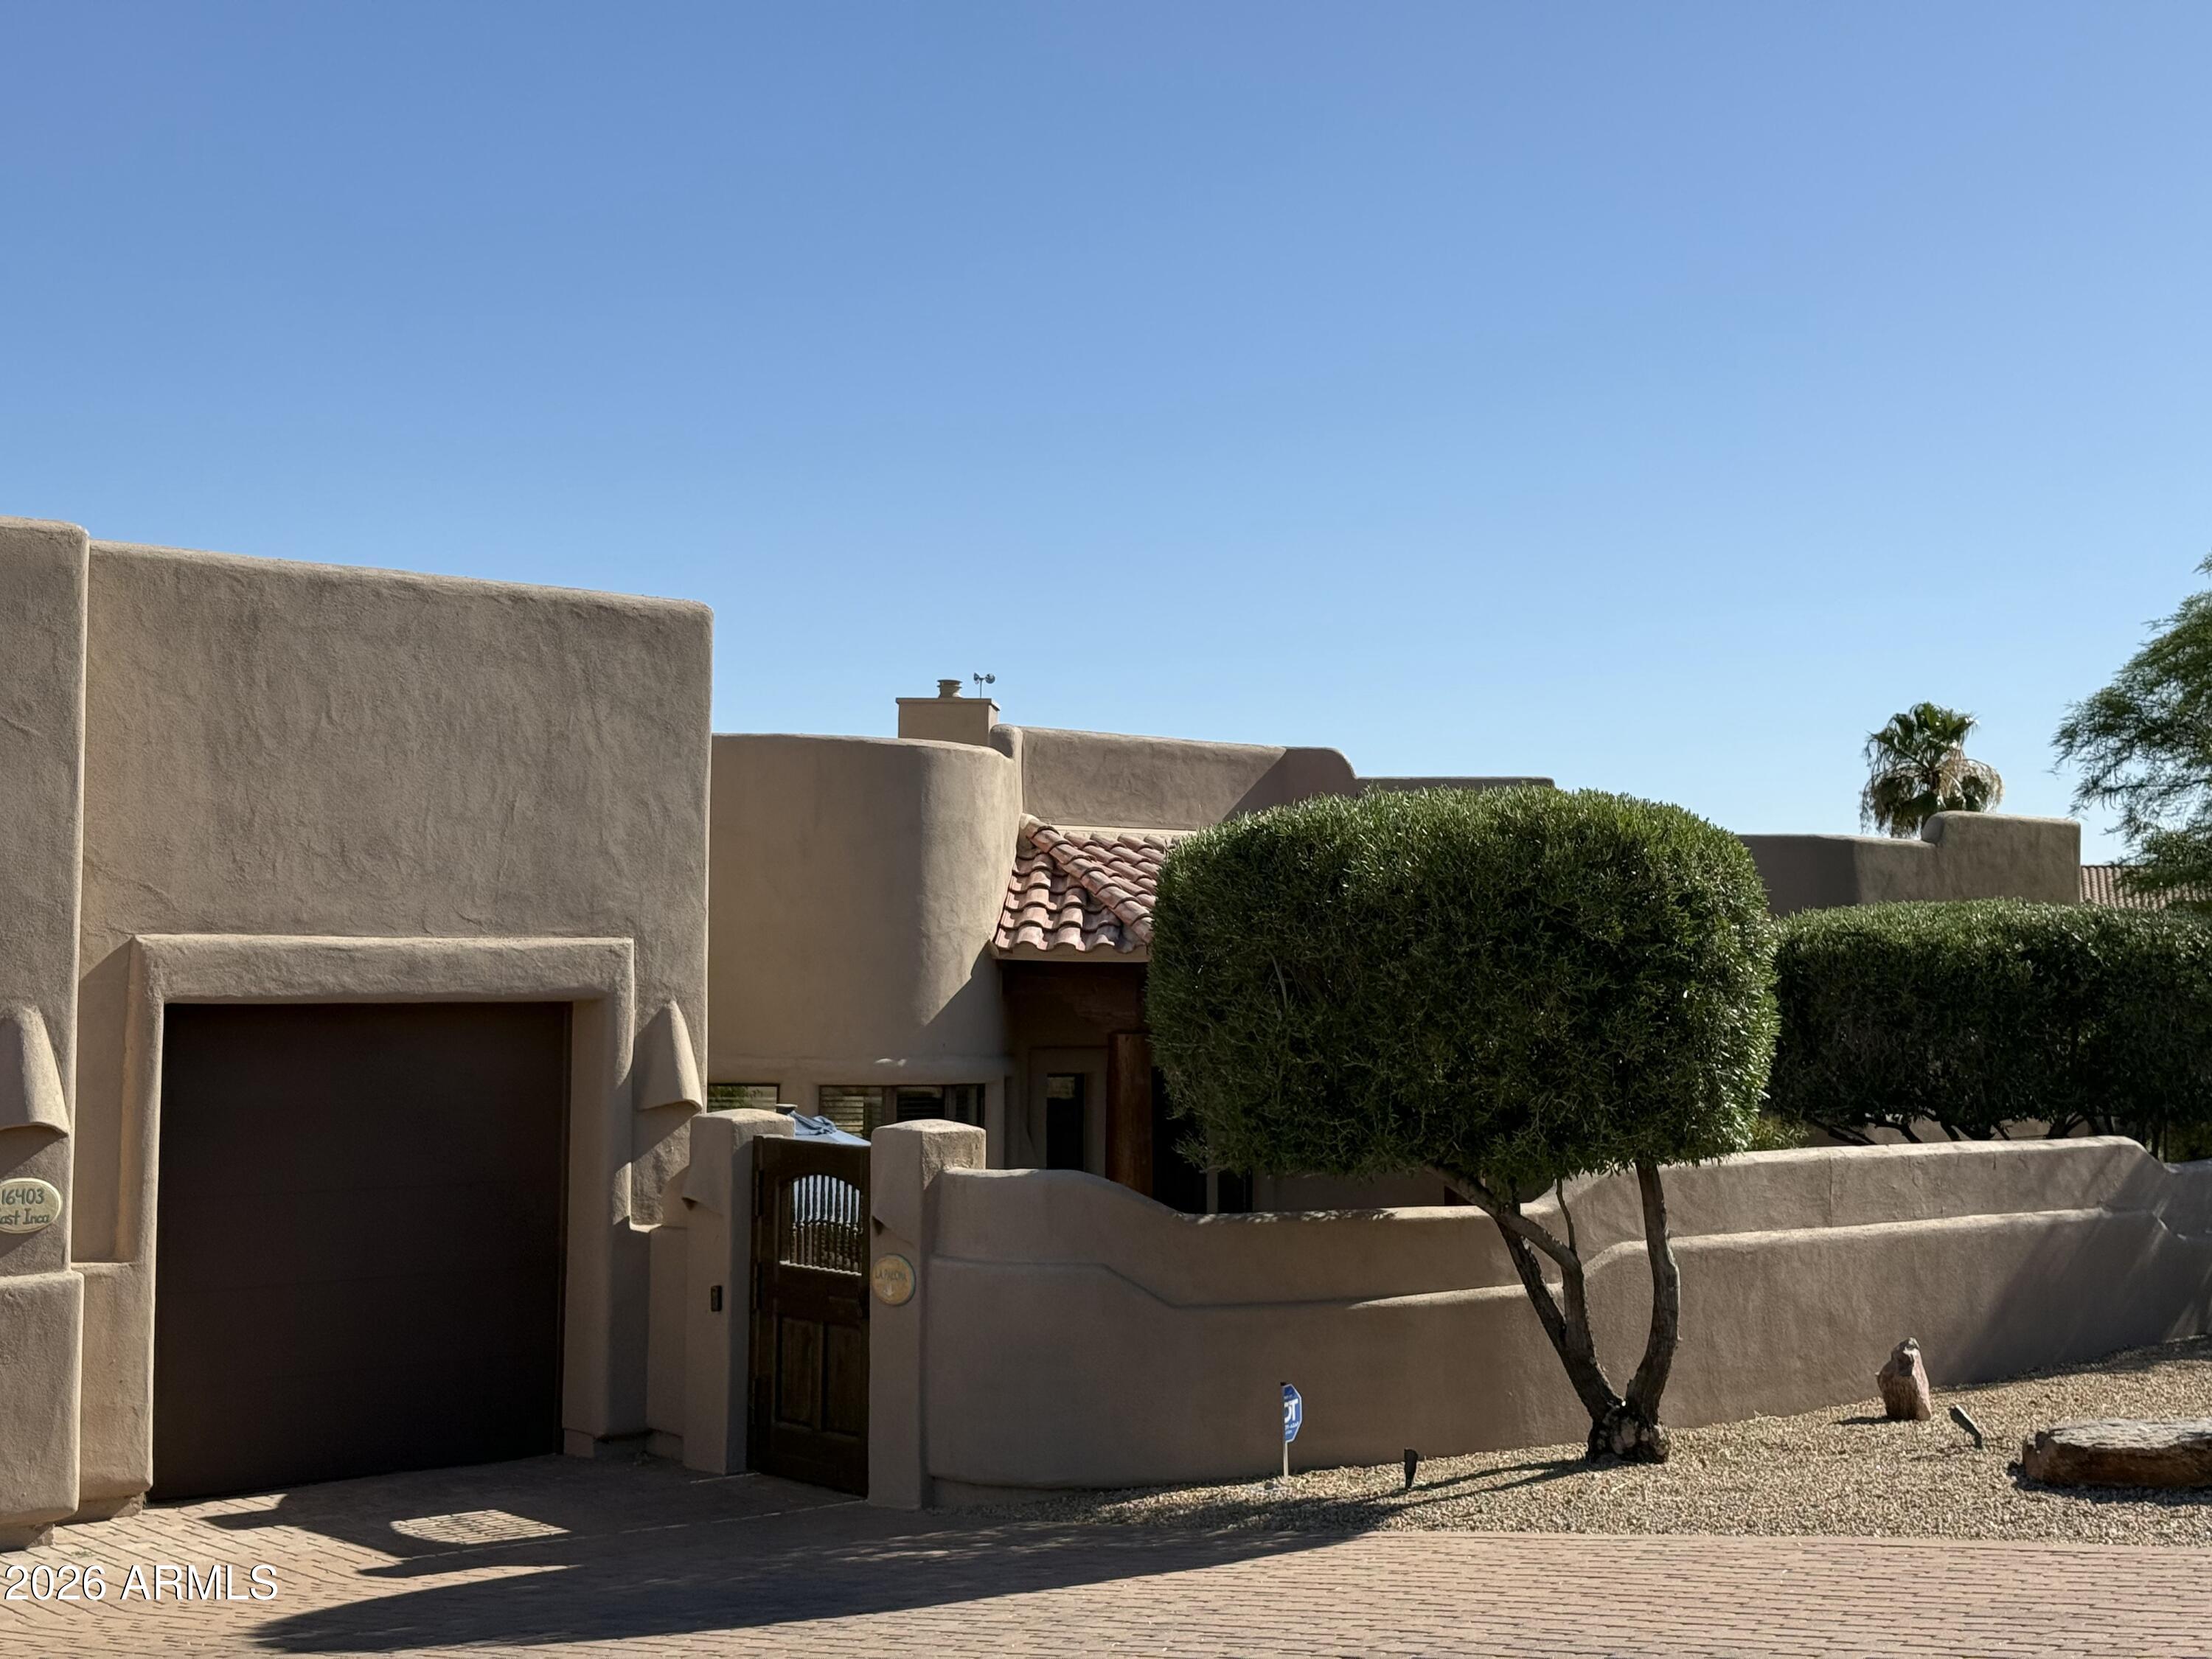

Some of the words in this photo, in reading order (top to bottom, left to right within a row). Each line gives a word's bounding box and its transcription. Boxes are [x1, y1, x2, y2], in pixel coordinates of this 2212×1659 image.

[1, 1188, 44, 1205] 16403
[0, 1208, 21, 1225] ast
[22, 1208, 50, 1225] Inca
